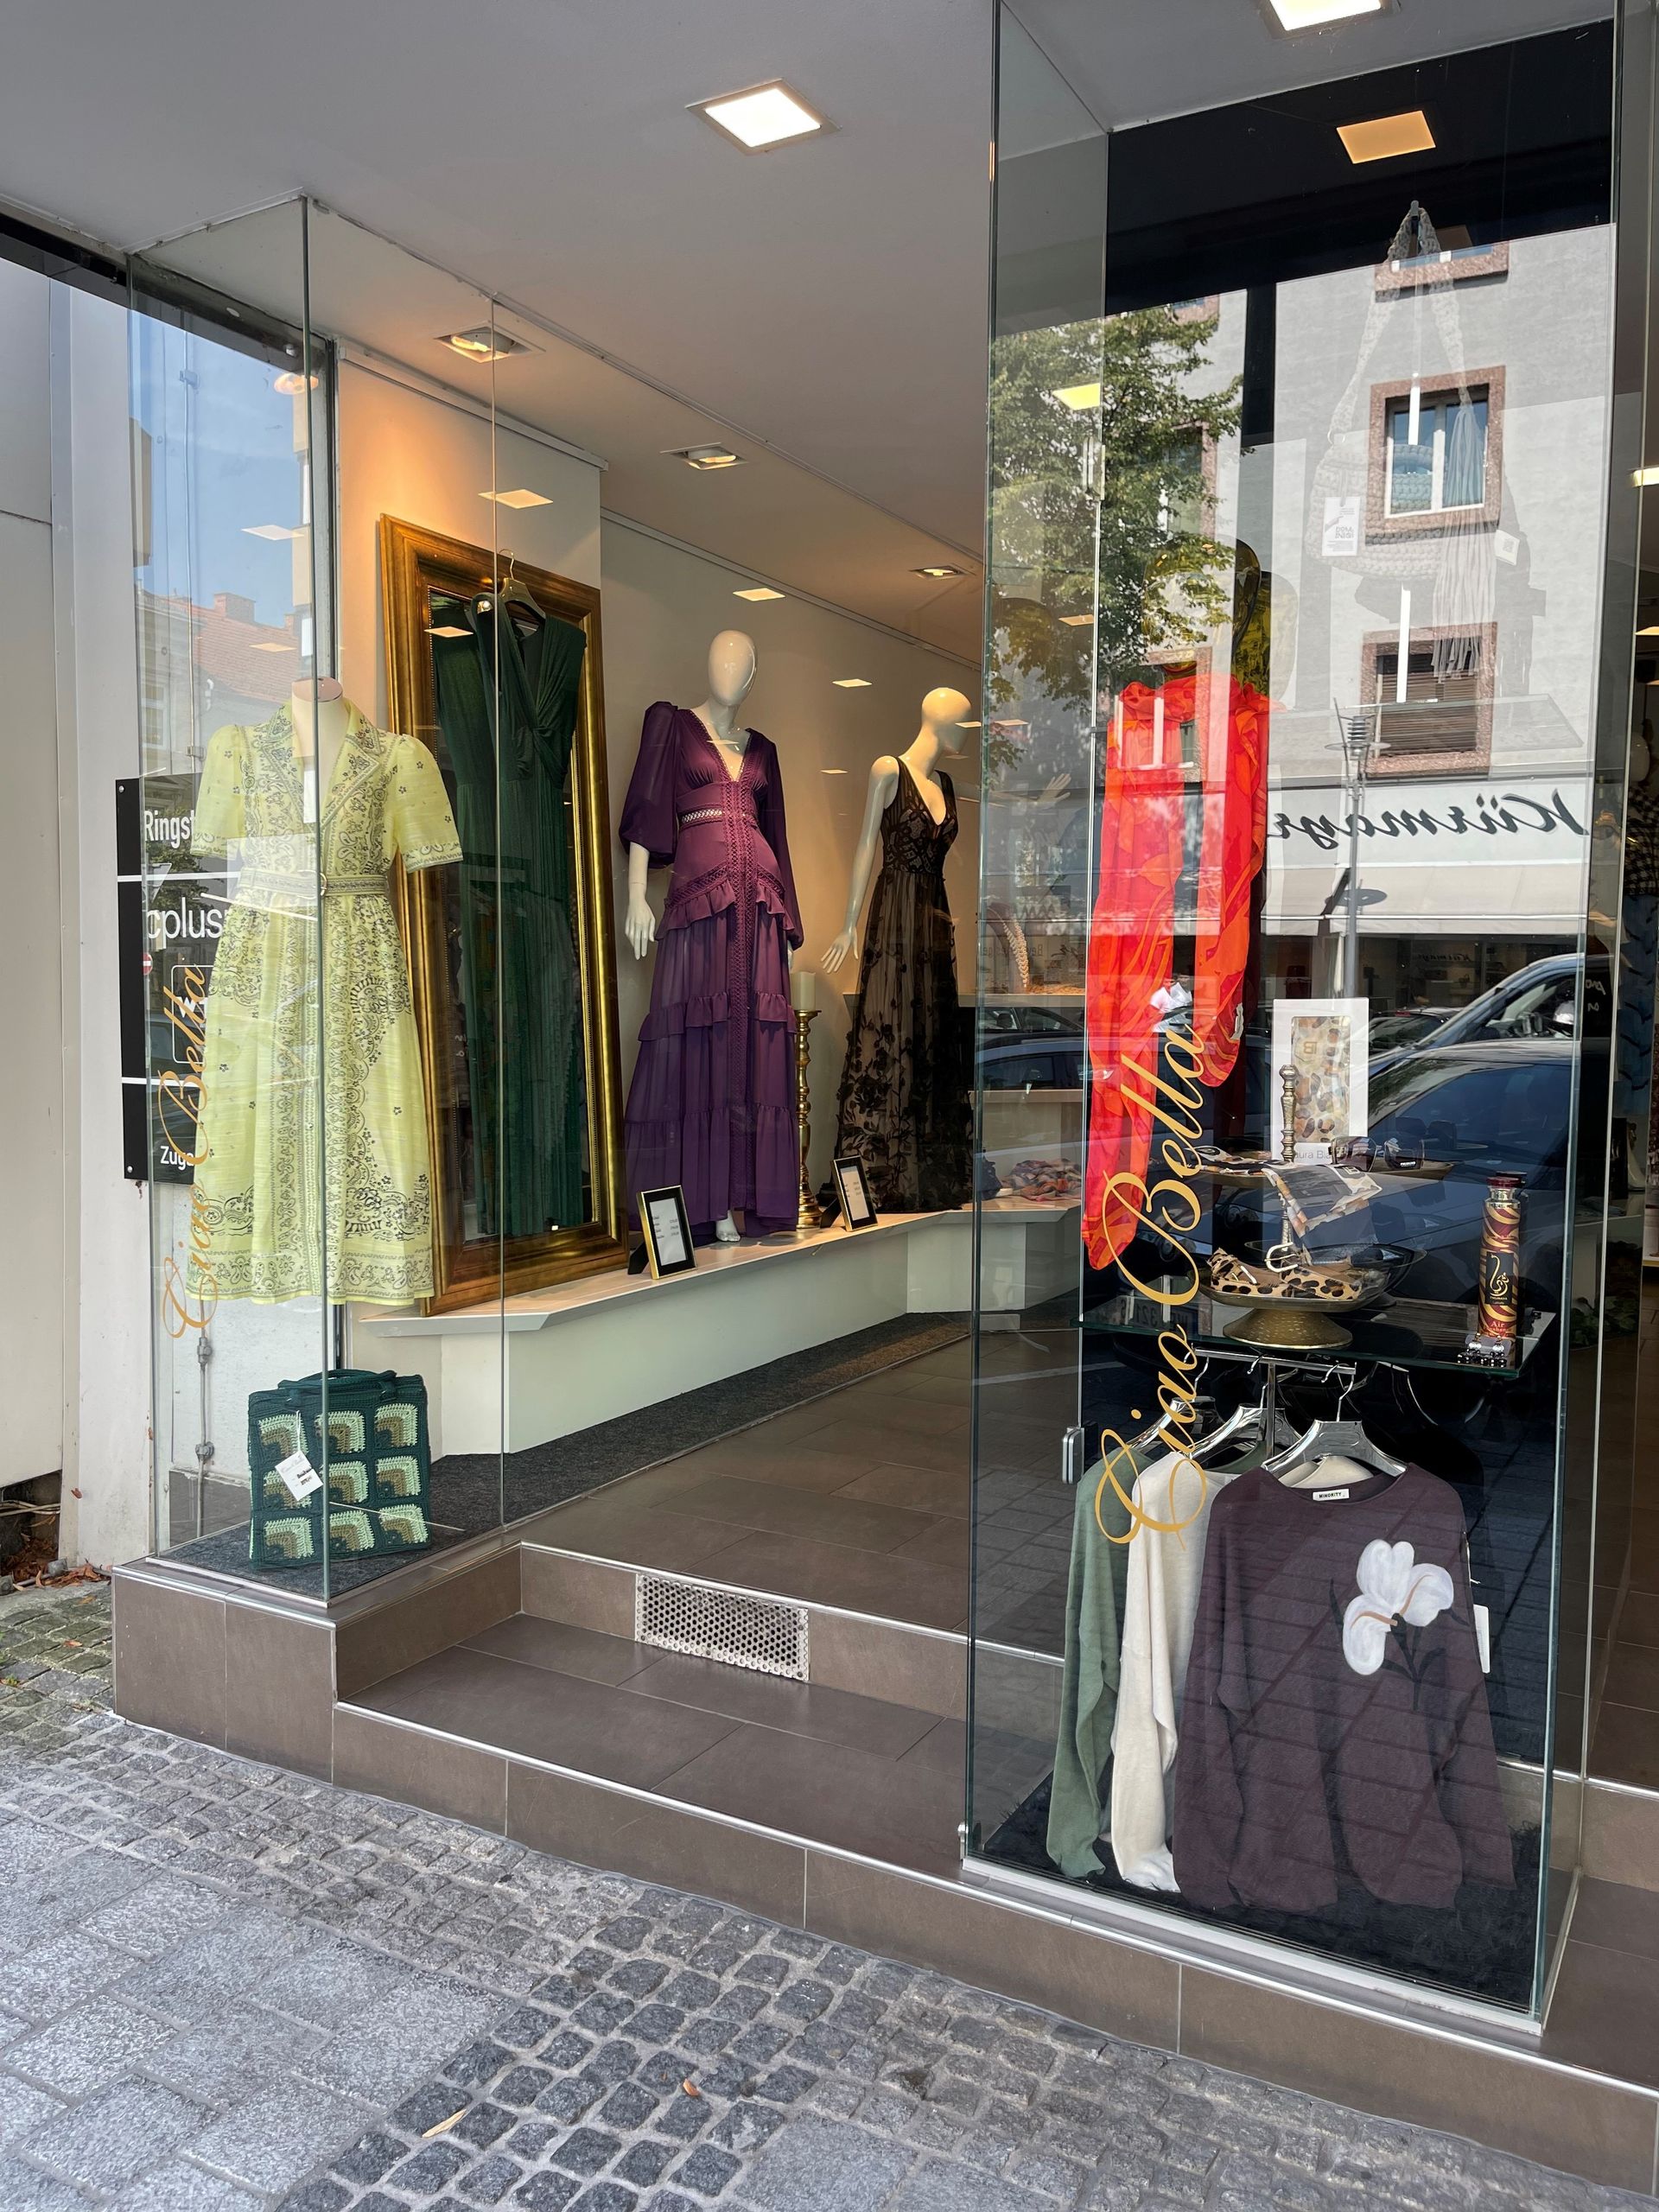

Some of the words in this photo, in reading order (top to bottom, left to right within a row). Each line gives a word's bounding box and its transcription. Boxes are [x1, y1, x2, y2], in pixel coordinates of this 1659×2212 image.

[158, 963, 209, 1165] Bella
[1103, 1024, 1205, 1306] Bella
[162, 1179, 218, 1338] Ciao
[1095, 1324, 1207, 1551] Ciao
